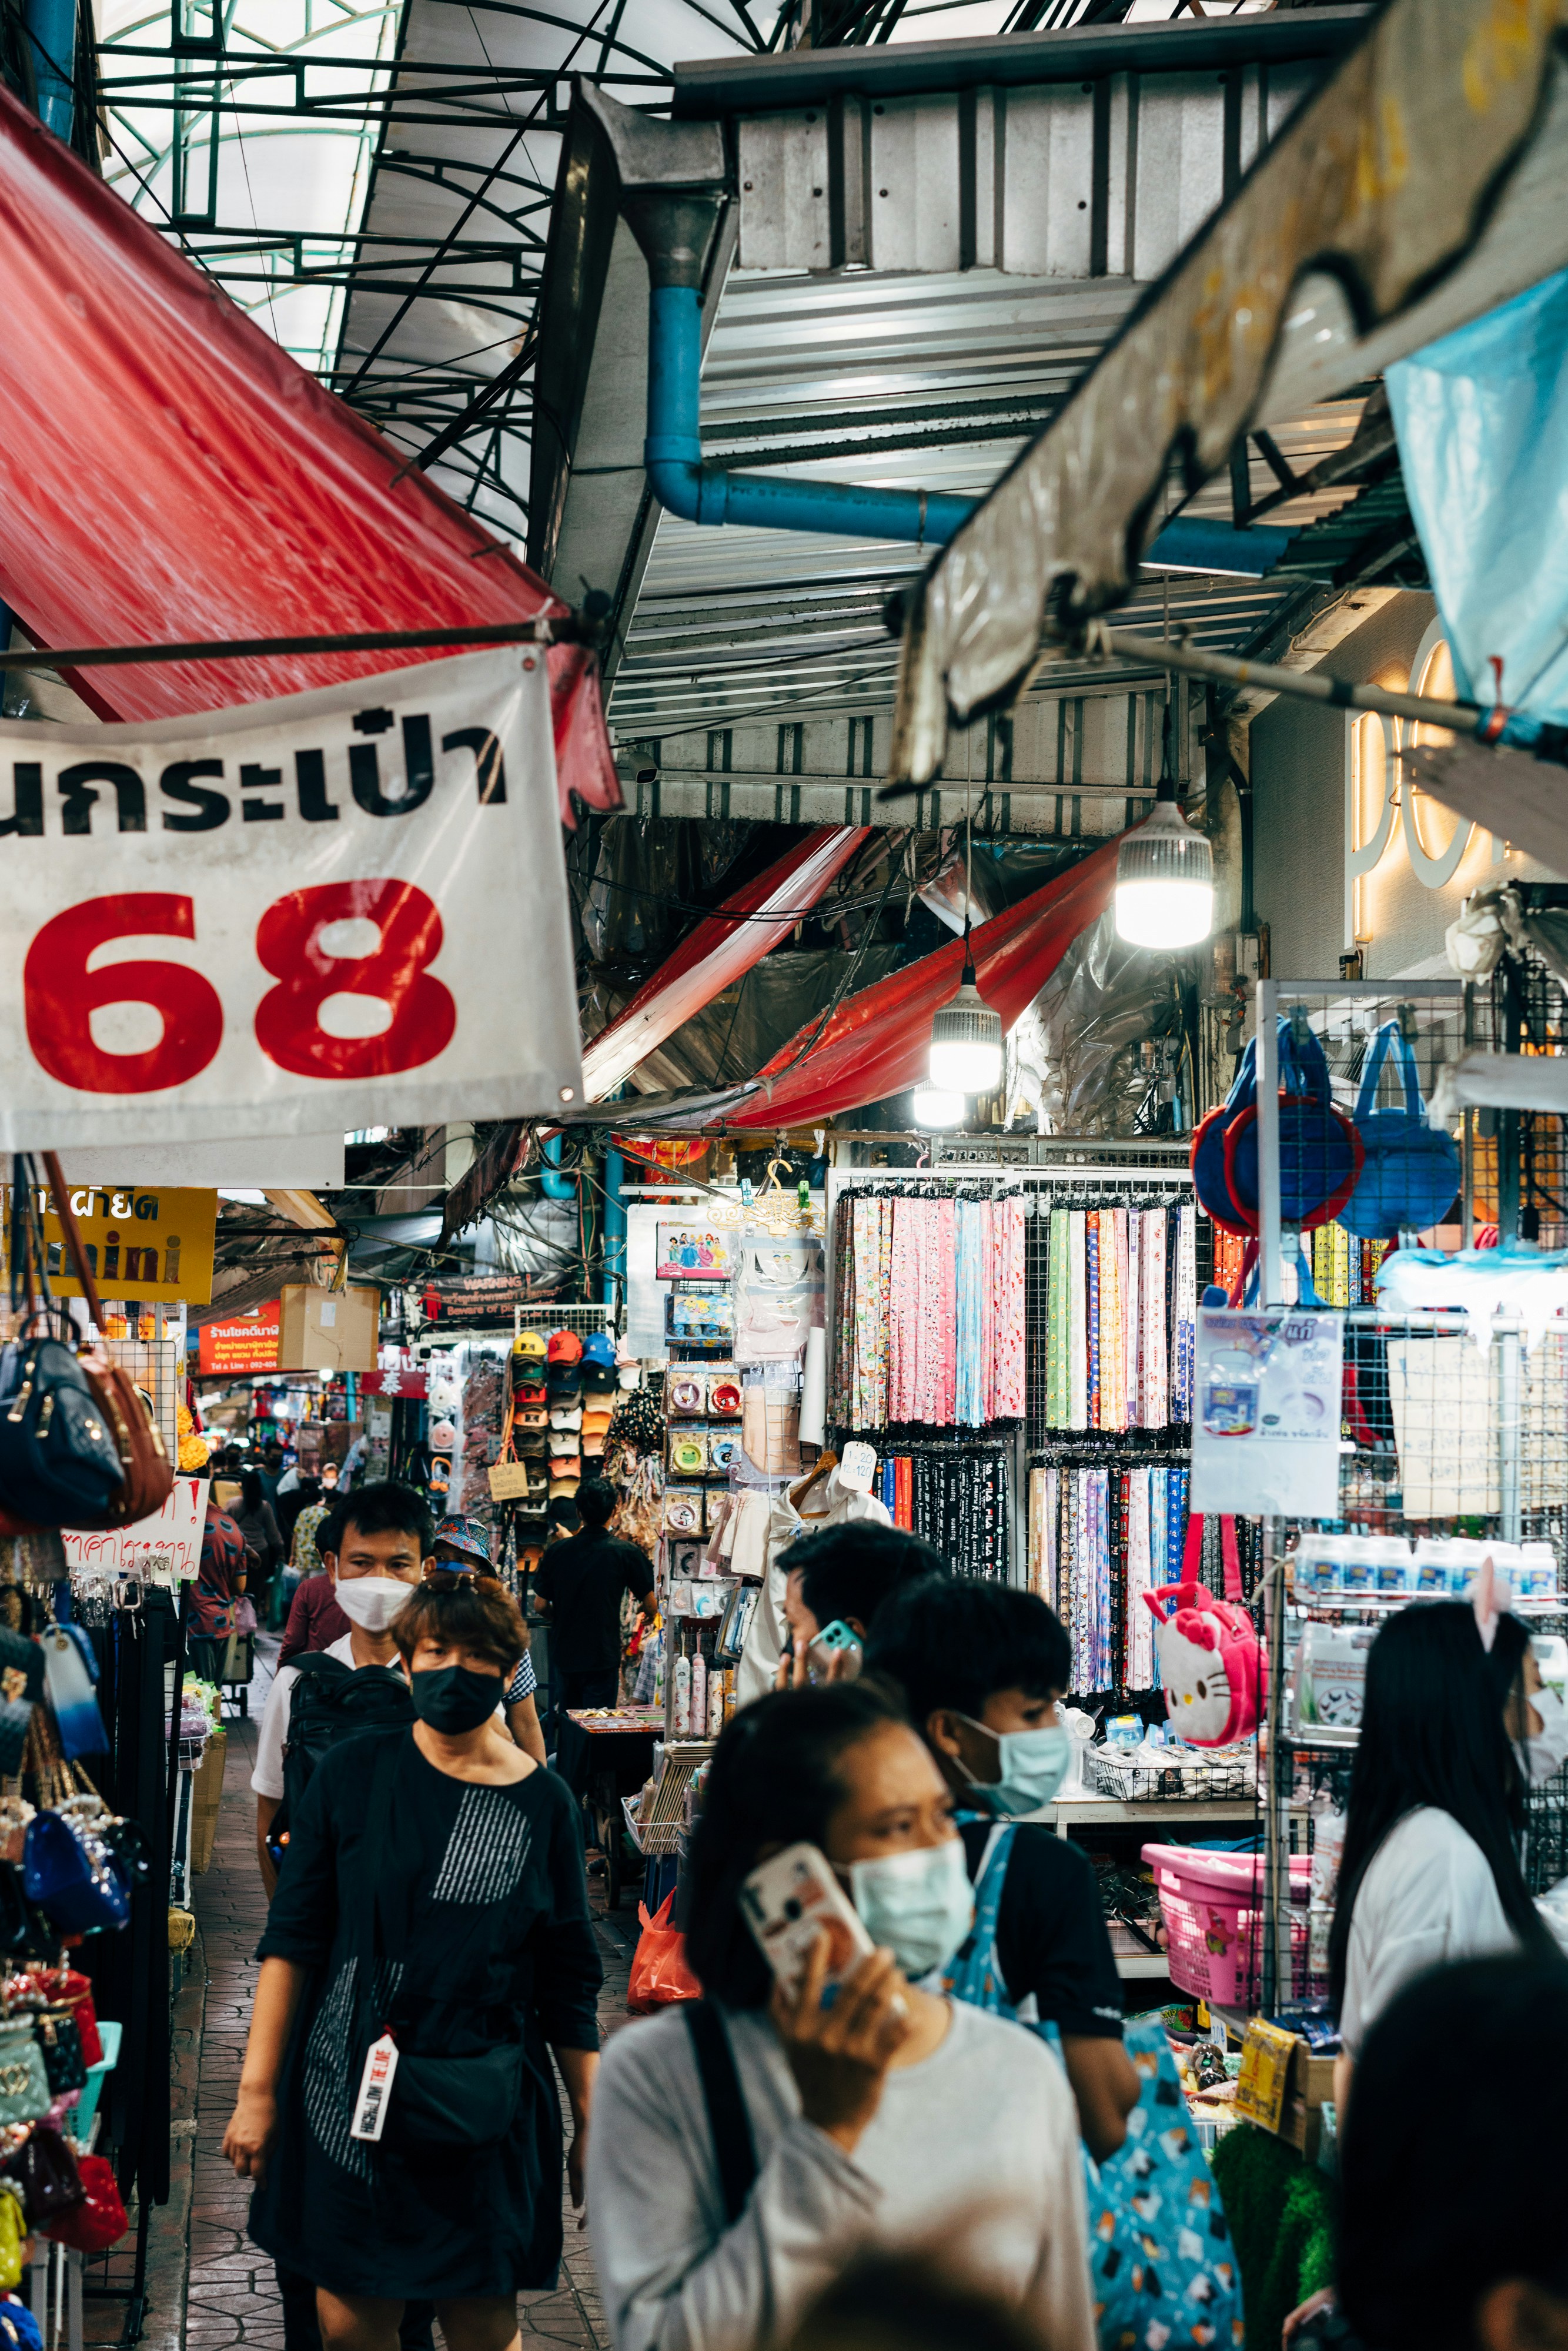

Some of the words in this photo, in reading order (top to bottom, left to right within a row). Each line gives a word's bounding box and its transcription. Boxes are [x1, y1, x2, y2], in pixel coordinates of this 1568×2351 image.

[24, 877, 457, 1094] 68
[463, 1276, 523, 1290] WARNING
[447, 1305, 484, 1316] Beware
[486, 1304, 498, 1313] of
[848, 1450, 852, 1459] 1
[860, 1452, 873, 1464] 20
[370, 2067, 387, 2082] THE
